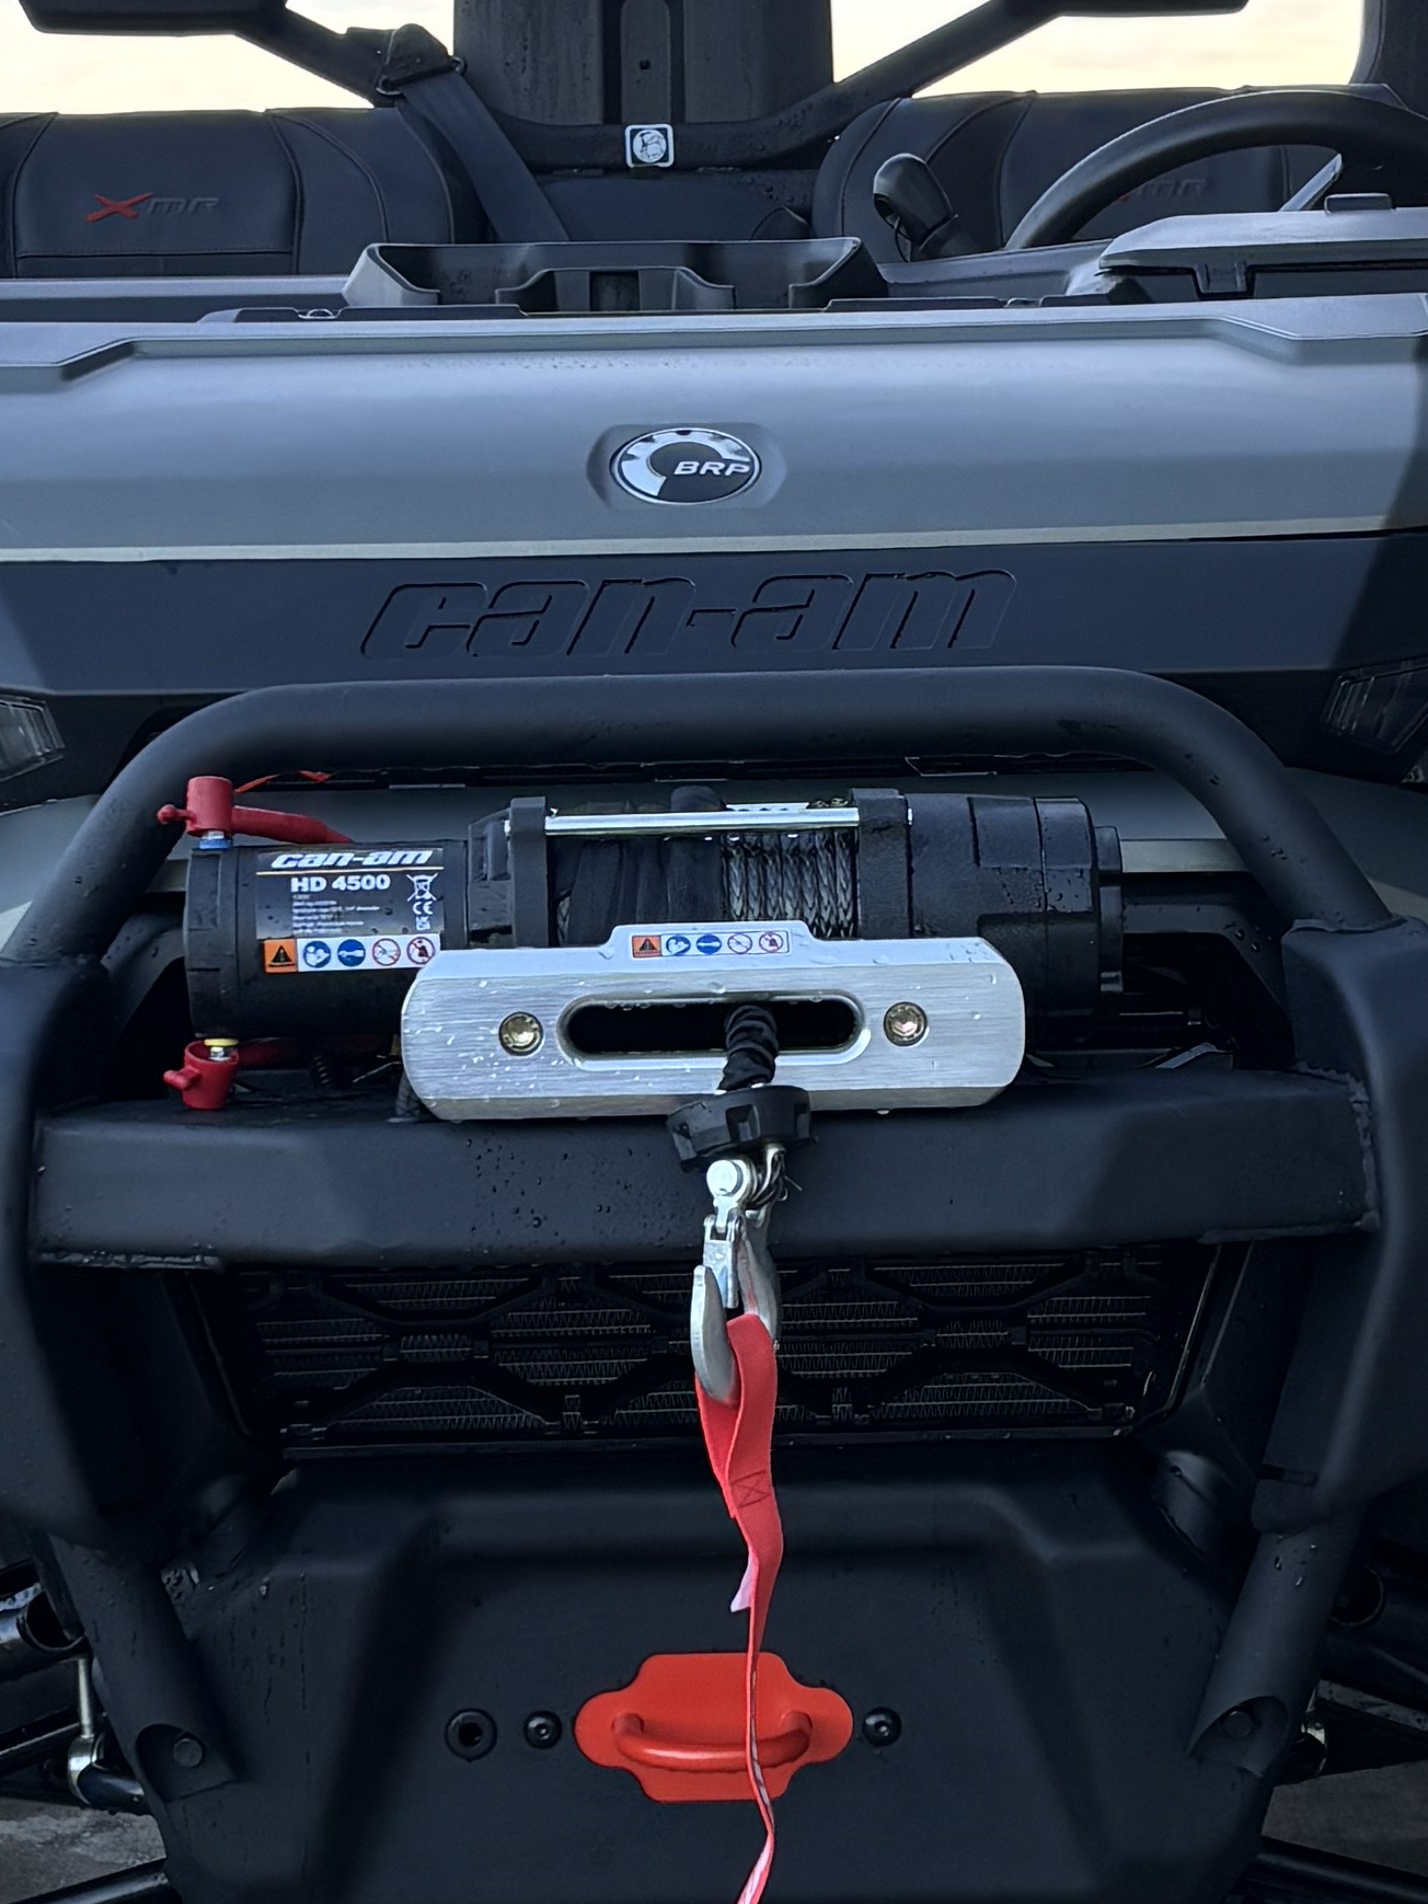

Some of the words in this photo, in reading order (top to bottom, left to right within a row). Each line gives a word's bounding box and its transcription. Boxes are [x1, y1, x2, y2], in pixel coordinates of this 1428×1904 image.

[673, 461, 751, 476] BRP
[360, 568, 1016, 658] can-am
[271, 850, 433, 869] can-am
[290, 877, 327, 893] HD
[331, 874, 391, 892] 4500
[412, 901, 433, 915] CE
